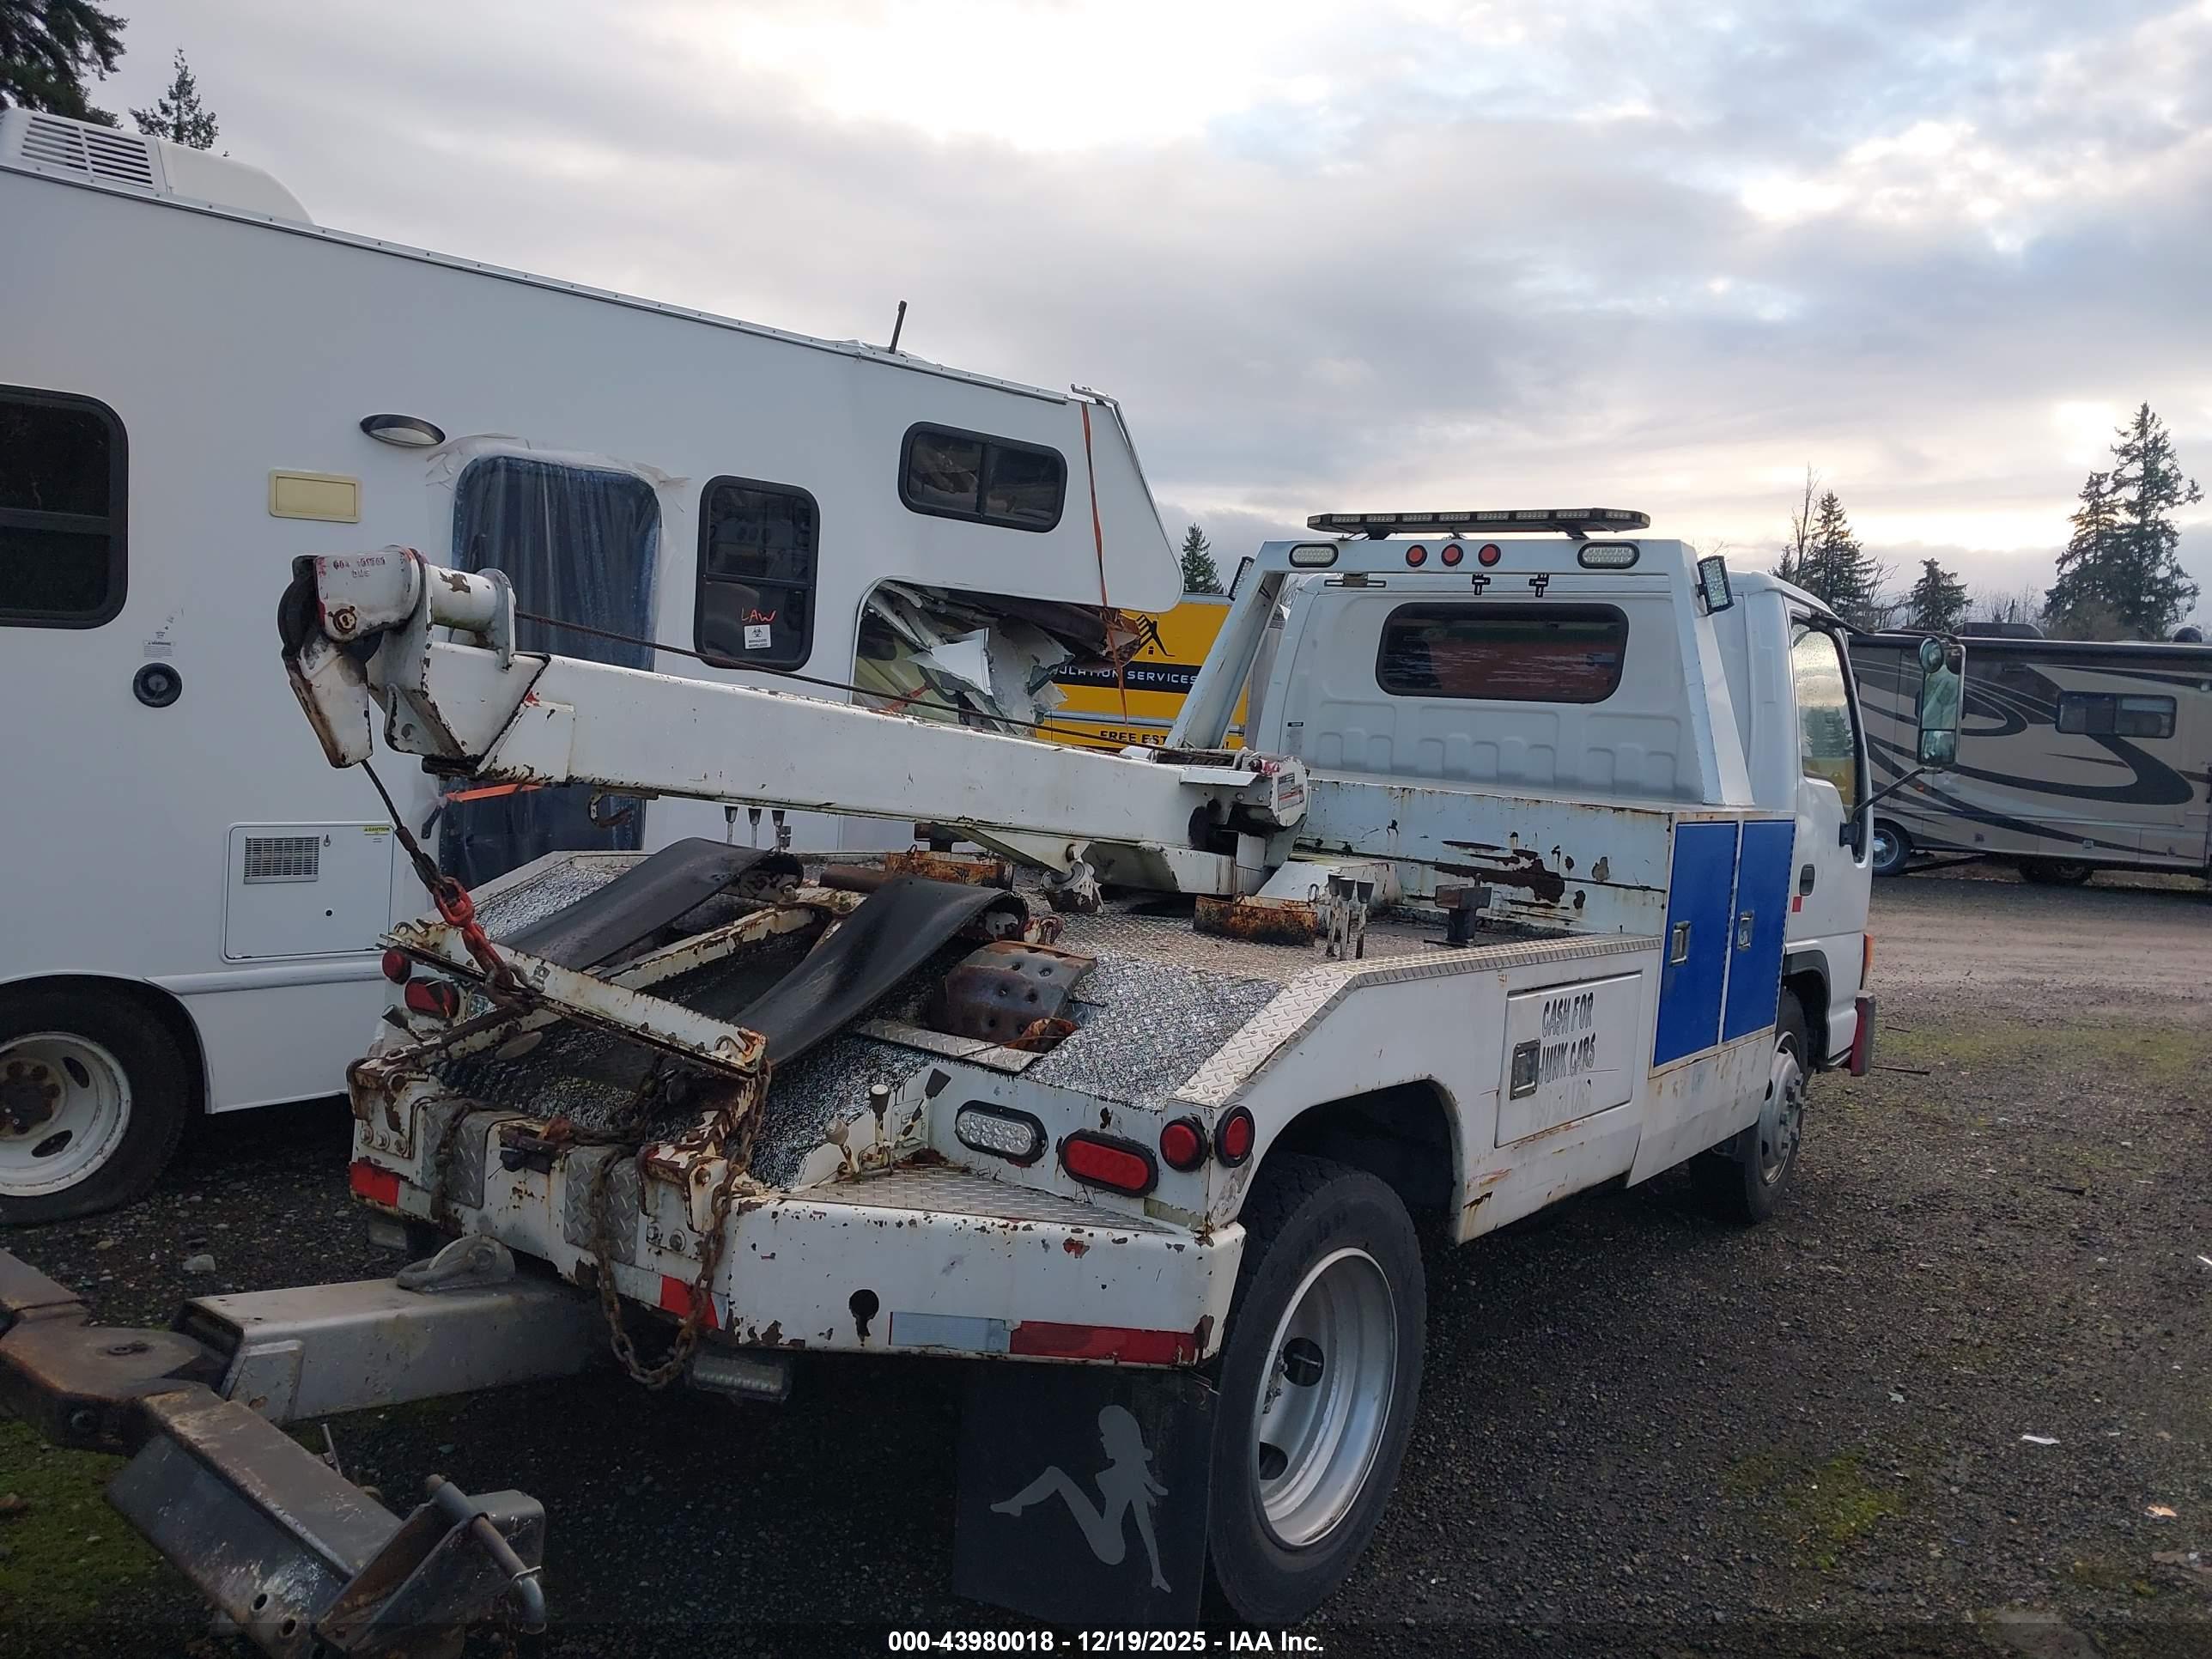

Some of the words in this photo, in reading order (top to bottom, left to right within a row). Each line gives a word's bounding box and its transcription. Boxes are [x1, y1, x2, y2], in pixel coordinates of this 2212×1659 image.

[741, 607, 777, 623] LAW
[1127, 671, 1198, 684] SERVICES
[1100, 730, 1137, 743] FREE
[1541, 997, 1571, 1038] CASH
[1571, 991, 1595, 1032] FOR
[1538, 1041, 1569, 1085] JUNK
[1569, 1031, 1596, 1078] CARS
